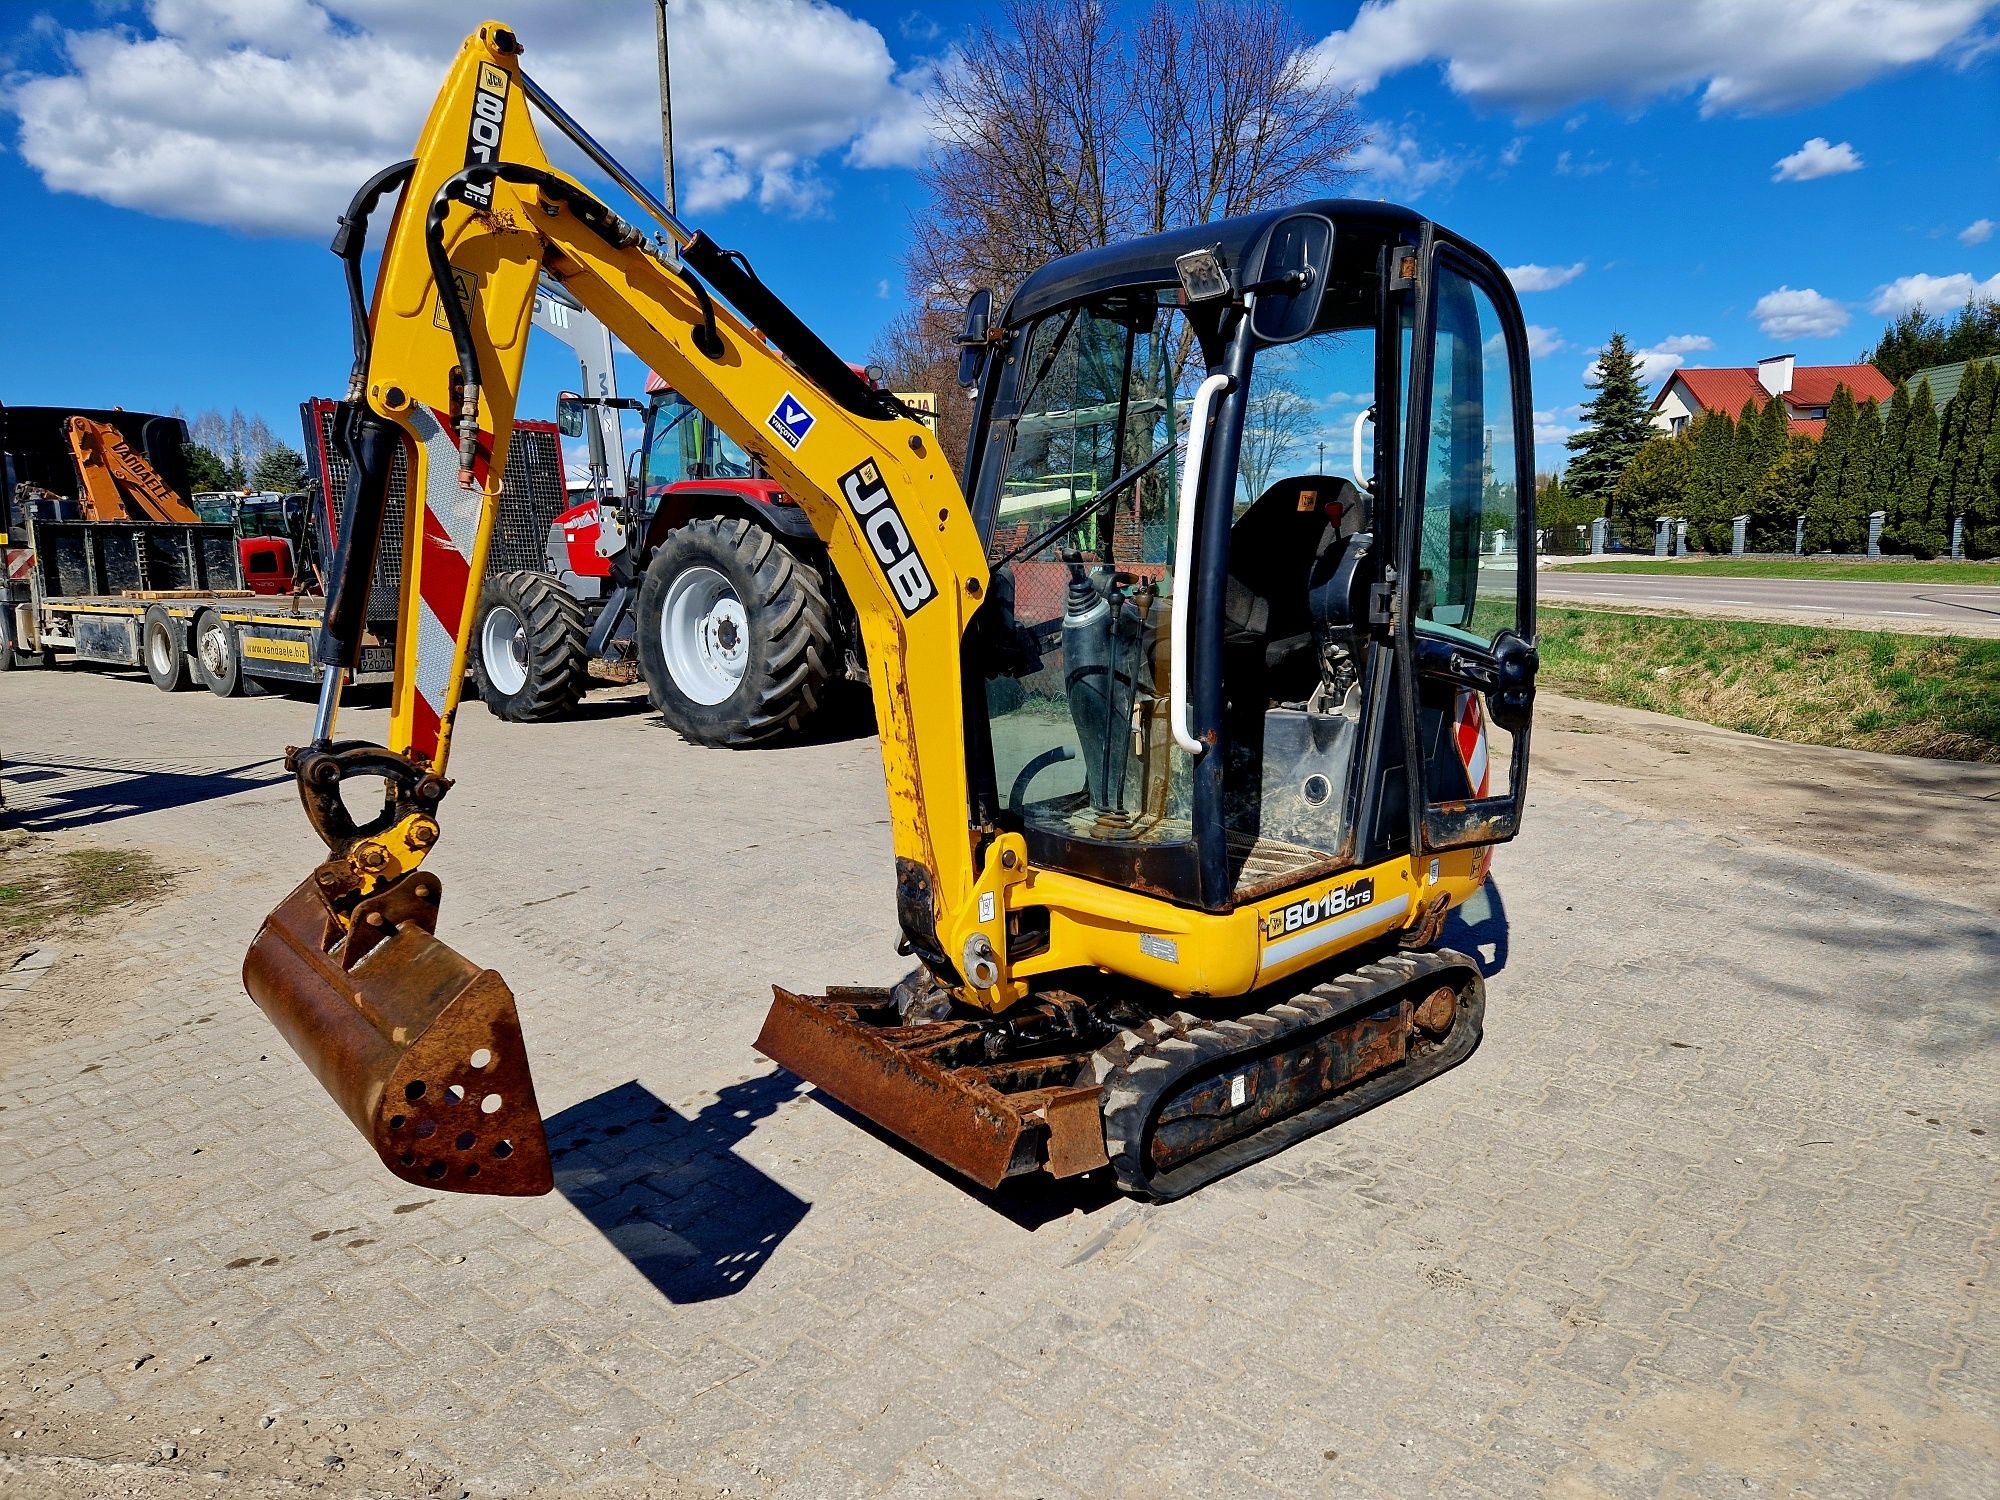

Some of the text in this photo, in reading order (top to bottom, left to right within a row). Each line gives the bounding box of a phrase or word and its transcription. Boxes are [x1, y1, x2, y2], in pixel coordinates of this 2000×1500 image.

[486, 70, 503, 88] JCB
[463, 190, 488, 205] CTS
[771, 417, 798, 446] VINÇOTTE
[111, 441, 172, 502] VANDAELE
[844, 473, 932, 611] JCB
[246, 644, 306, 659] www.vandaele.biz
[367, 649, 386, 660] BIA
[1285, 888, 1346, 931] 8018
[1345, 889, 1371, 909] CTS
